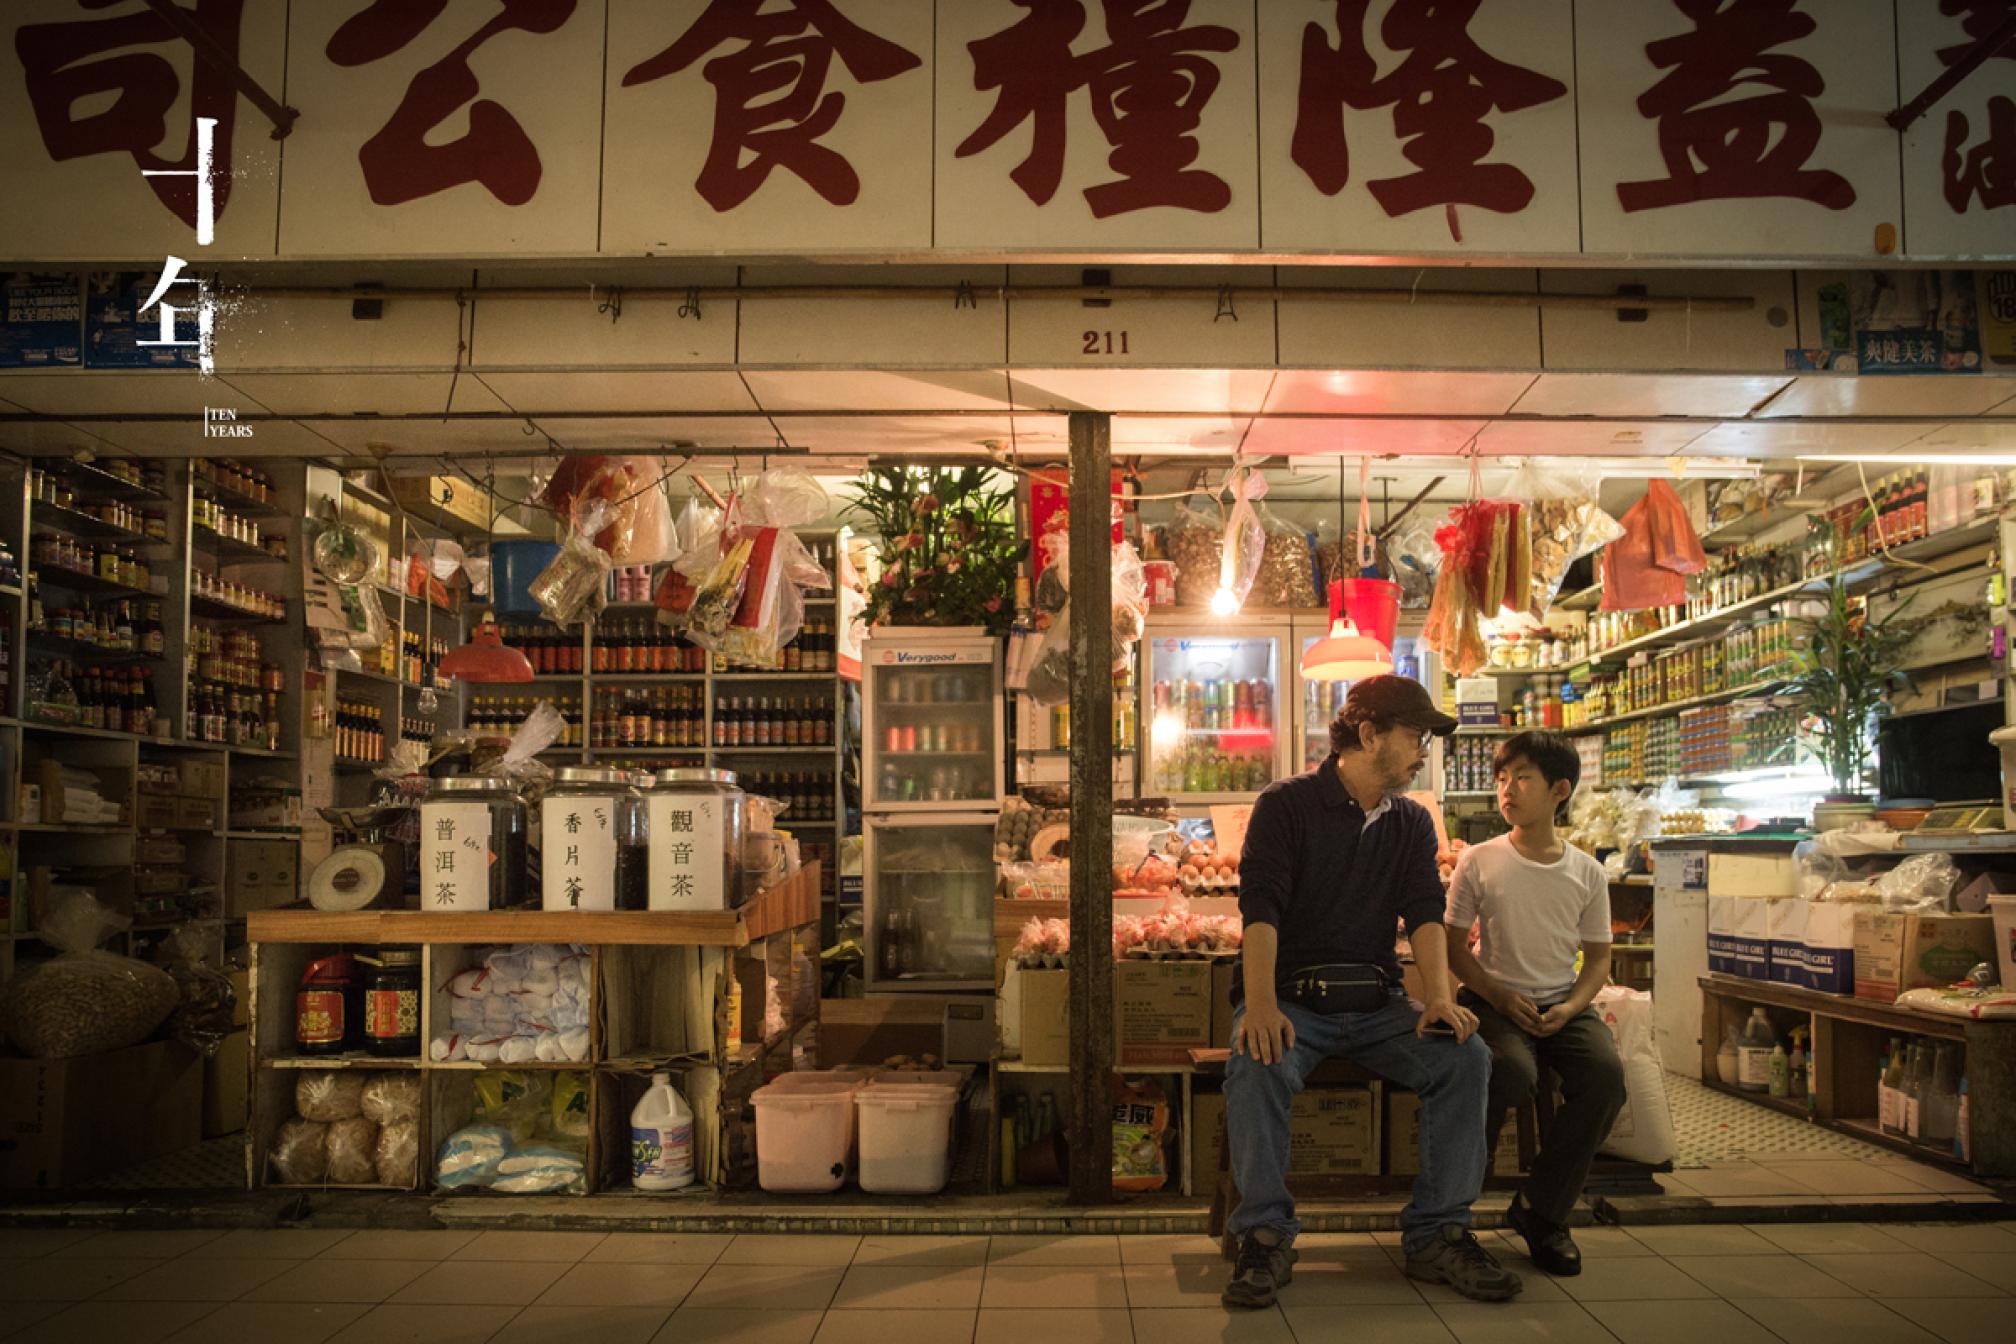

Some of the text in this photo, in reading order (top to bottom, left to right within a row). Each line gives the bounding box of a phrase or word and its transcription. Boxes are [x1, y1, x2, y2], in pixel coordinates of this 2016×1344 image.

[1082, 330, 1130, 354] 211
[1865, 337, 1937, 364] 爽健美茶
[896, 651, 957, 664] Verygood
[435, 817, 457, 905] 普洱茶
[563, 812, 584, 905] 香片茶
[671, 809, 694, 898] 觀音茶
